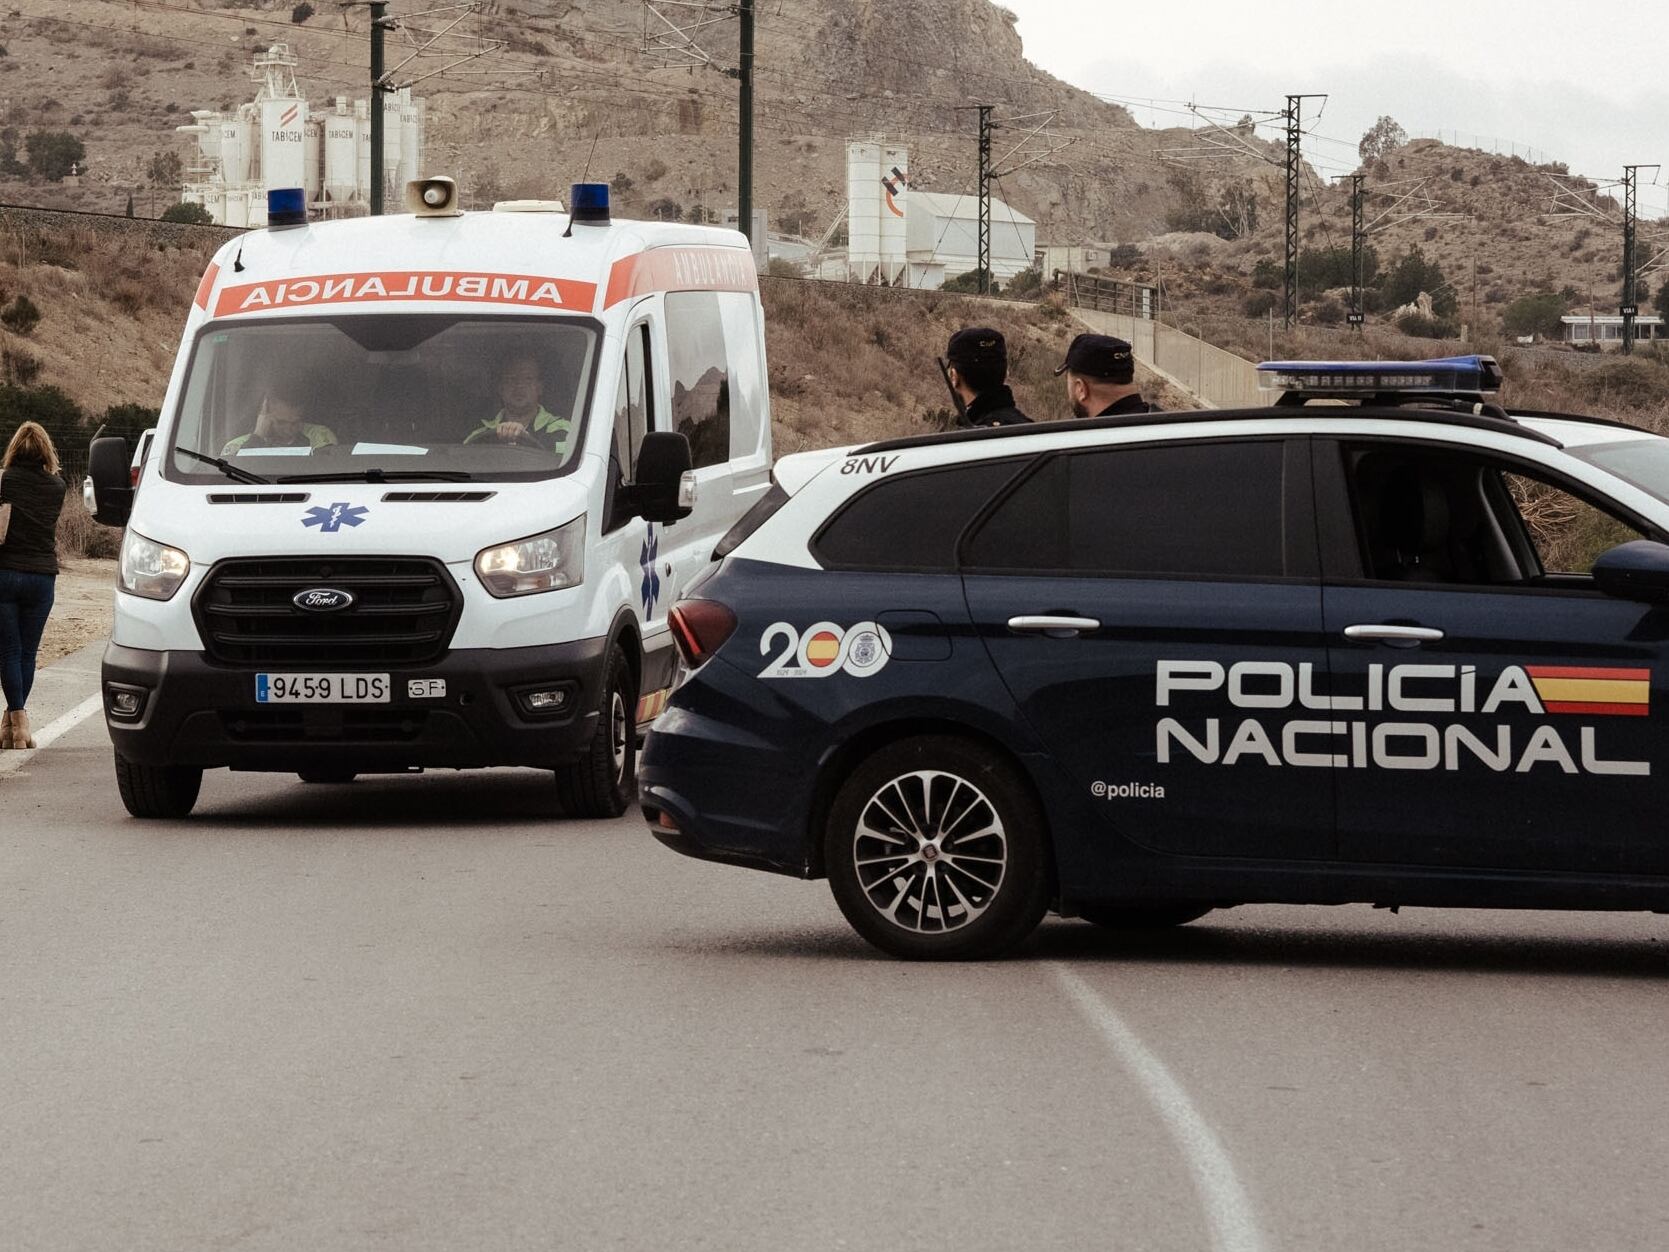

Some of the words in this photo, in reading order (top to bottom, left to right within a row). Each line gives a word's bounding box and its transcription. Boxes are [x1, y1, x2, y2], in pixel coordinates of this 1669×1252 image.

[328, 130, 353, 139] TABICEM
[841, 455, 900, 475] 8NV
[305, 592, 338, 606] Ford
[756, 621, 893, 678] 200
[273, 677, 331, 699] 9459
[341, 677, 384, 699] LDS
[411, 681, 439, 696] SF
[1156, 717, 1651, 776] NACIONAL
[1090, 780, 1165, 801] @policia
